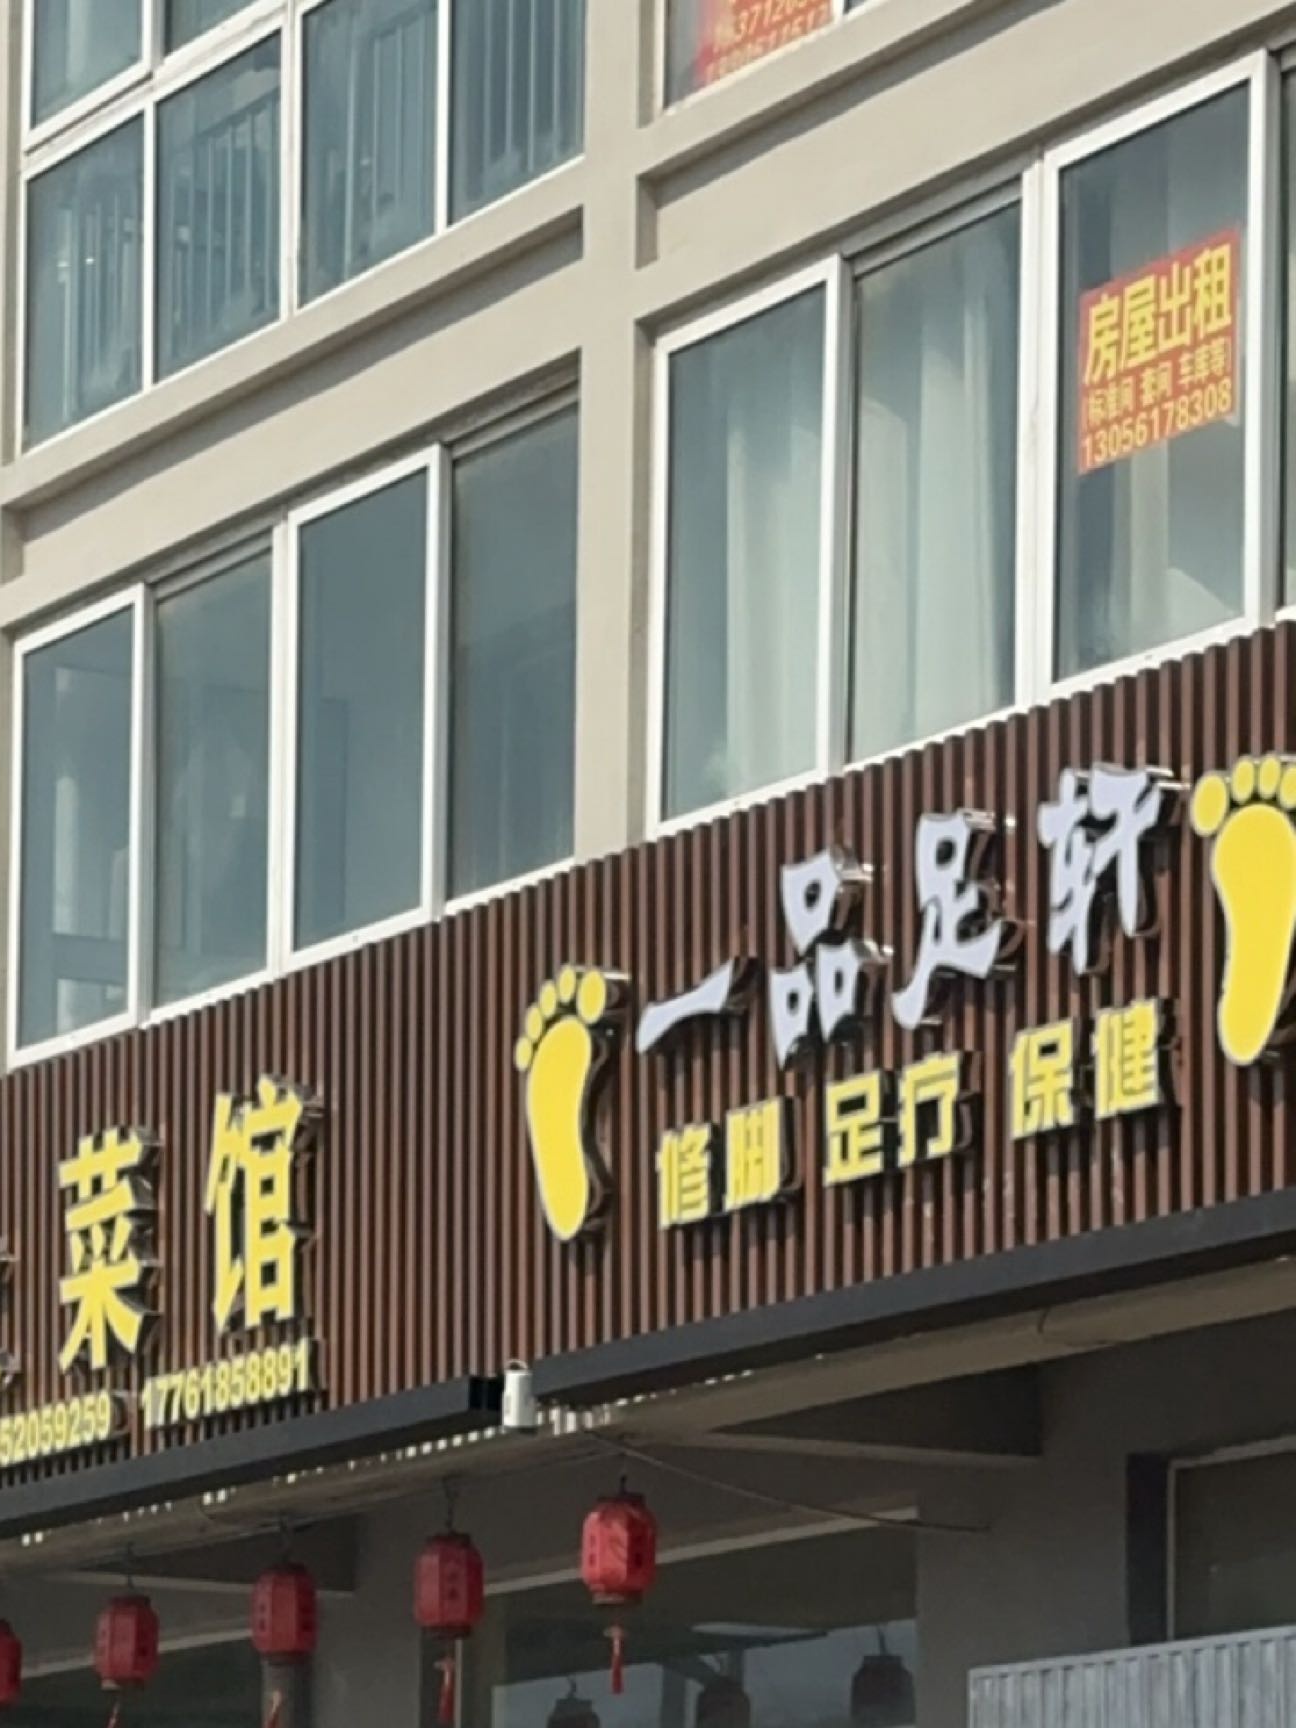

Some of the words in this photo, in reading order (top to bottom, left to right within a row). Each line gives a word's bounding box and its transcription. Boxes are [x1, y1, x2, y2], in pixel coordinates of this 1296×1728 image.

[1084, 243, 1232, 386] 房屋出租
[1083, 377, 1233, 469] 13056178308
[636, 762, 1168, 1067] 一品足轩
[656, 1094, 786, 1230] 修脚
[824, 1051, 964, 1188] 足疗
[1008, 997, 1164, 1140] 保健
[141, 1336, 312, 1432] 17761858891
